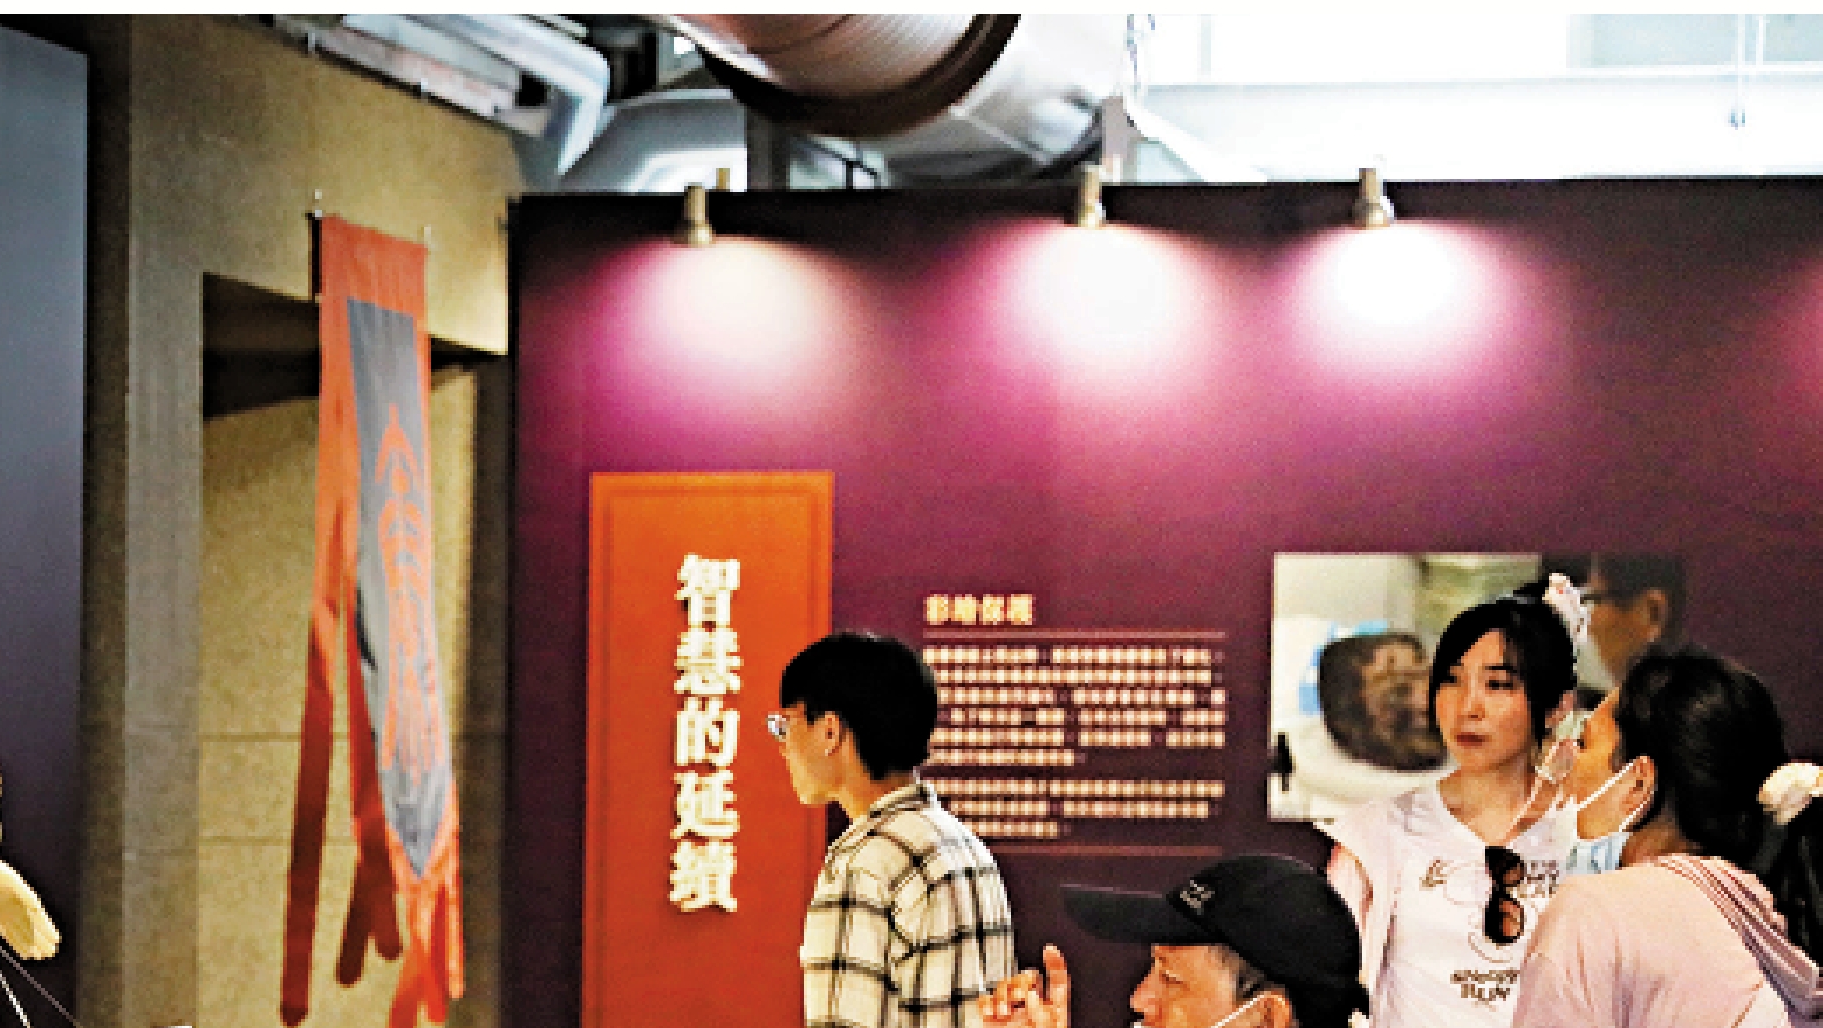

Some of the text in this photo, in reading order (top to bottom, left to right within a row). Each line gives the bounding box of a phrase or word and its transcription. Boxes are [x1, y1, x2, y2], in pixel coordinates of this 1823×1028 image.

[670, 553, 743, 912] 智慧的延續
